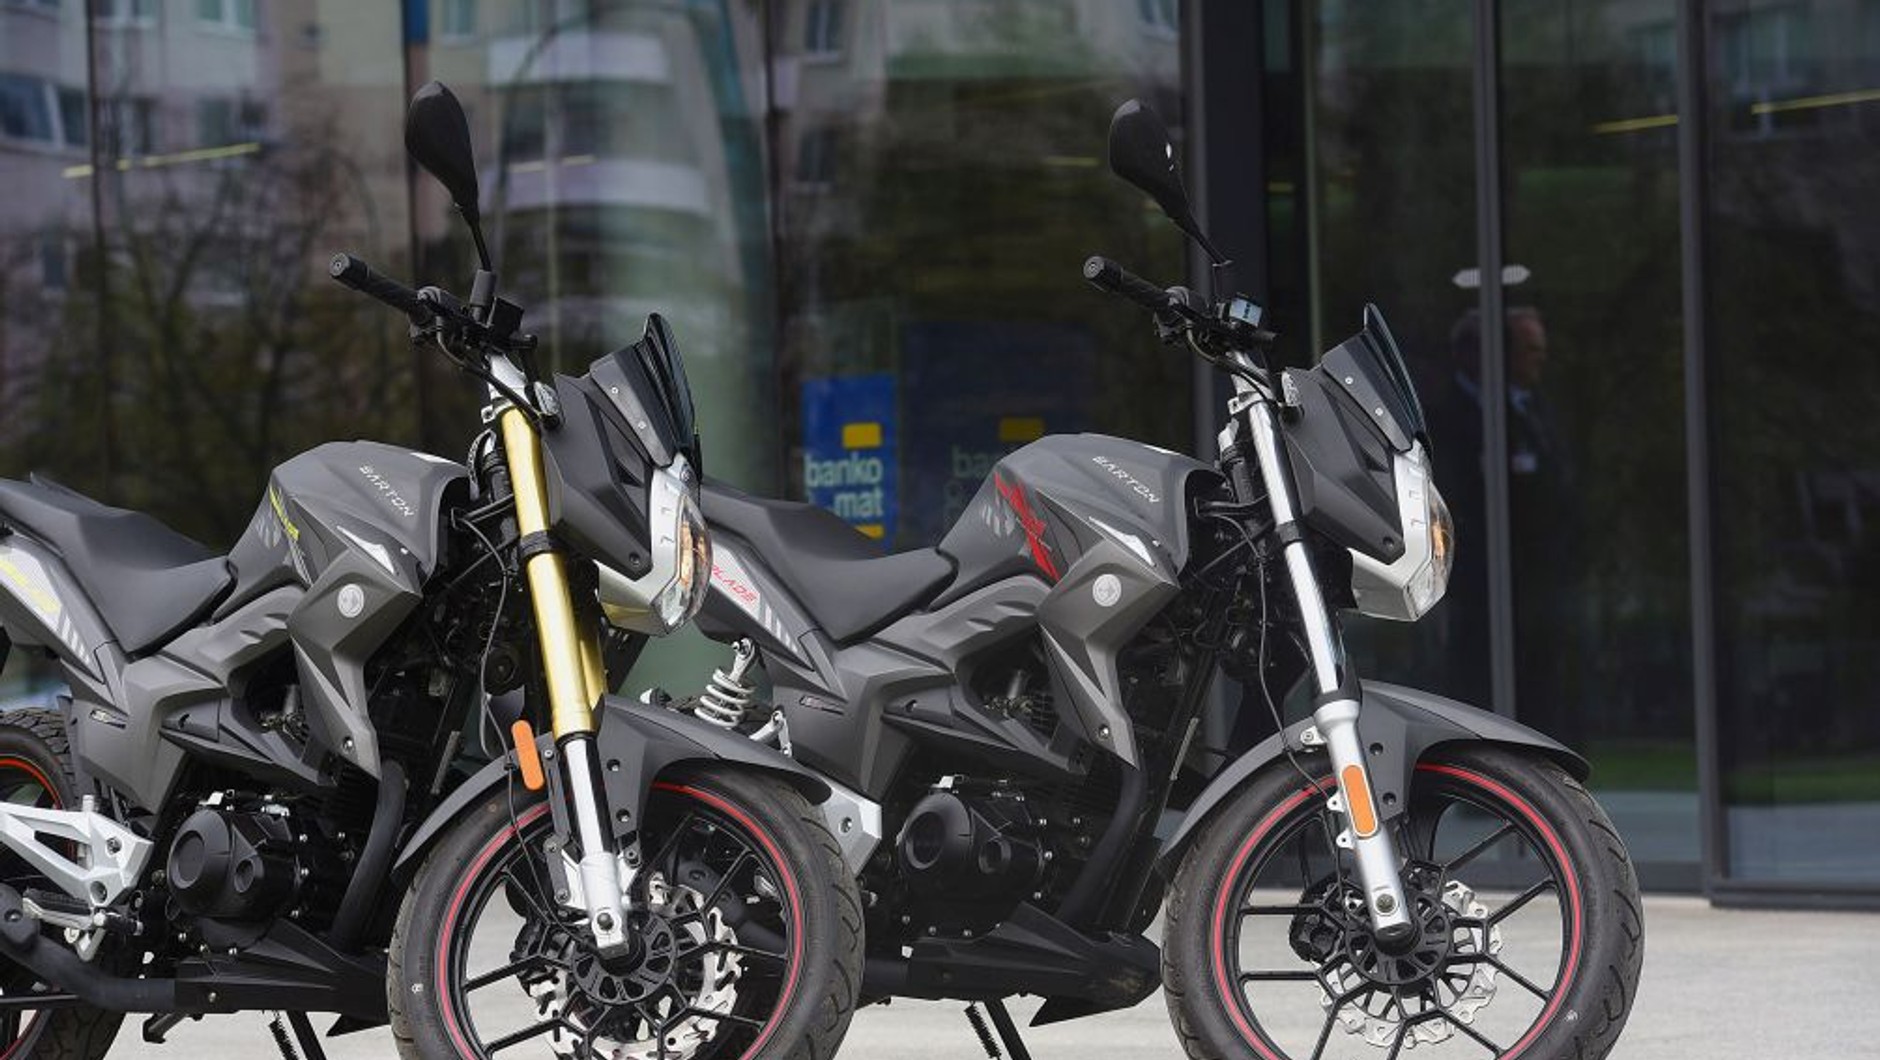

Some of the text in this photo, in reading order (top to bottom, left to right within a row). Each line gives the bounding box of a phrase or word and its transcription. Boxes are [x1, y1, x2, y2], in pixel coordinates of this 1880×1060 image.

[359, 465, 415, 517] BARTON
[804, 451, 883, 488] banko
[1092, 455, 1160, 503] BARTON
